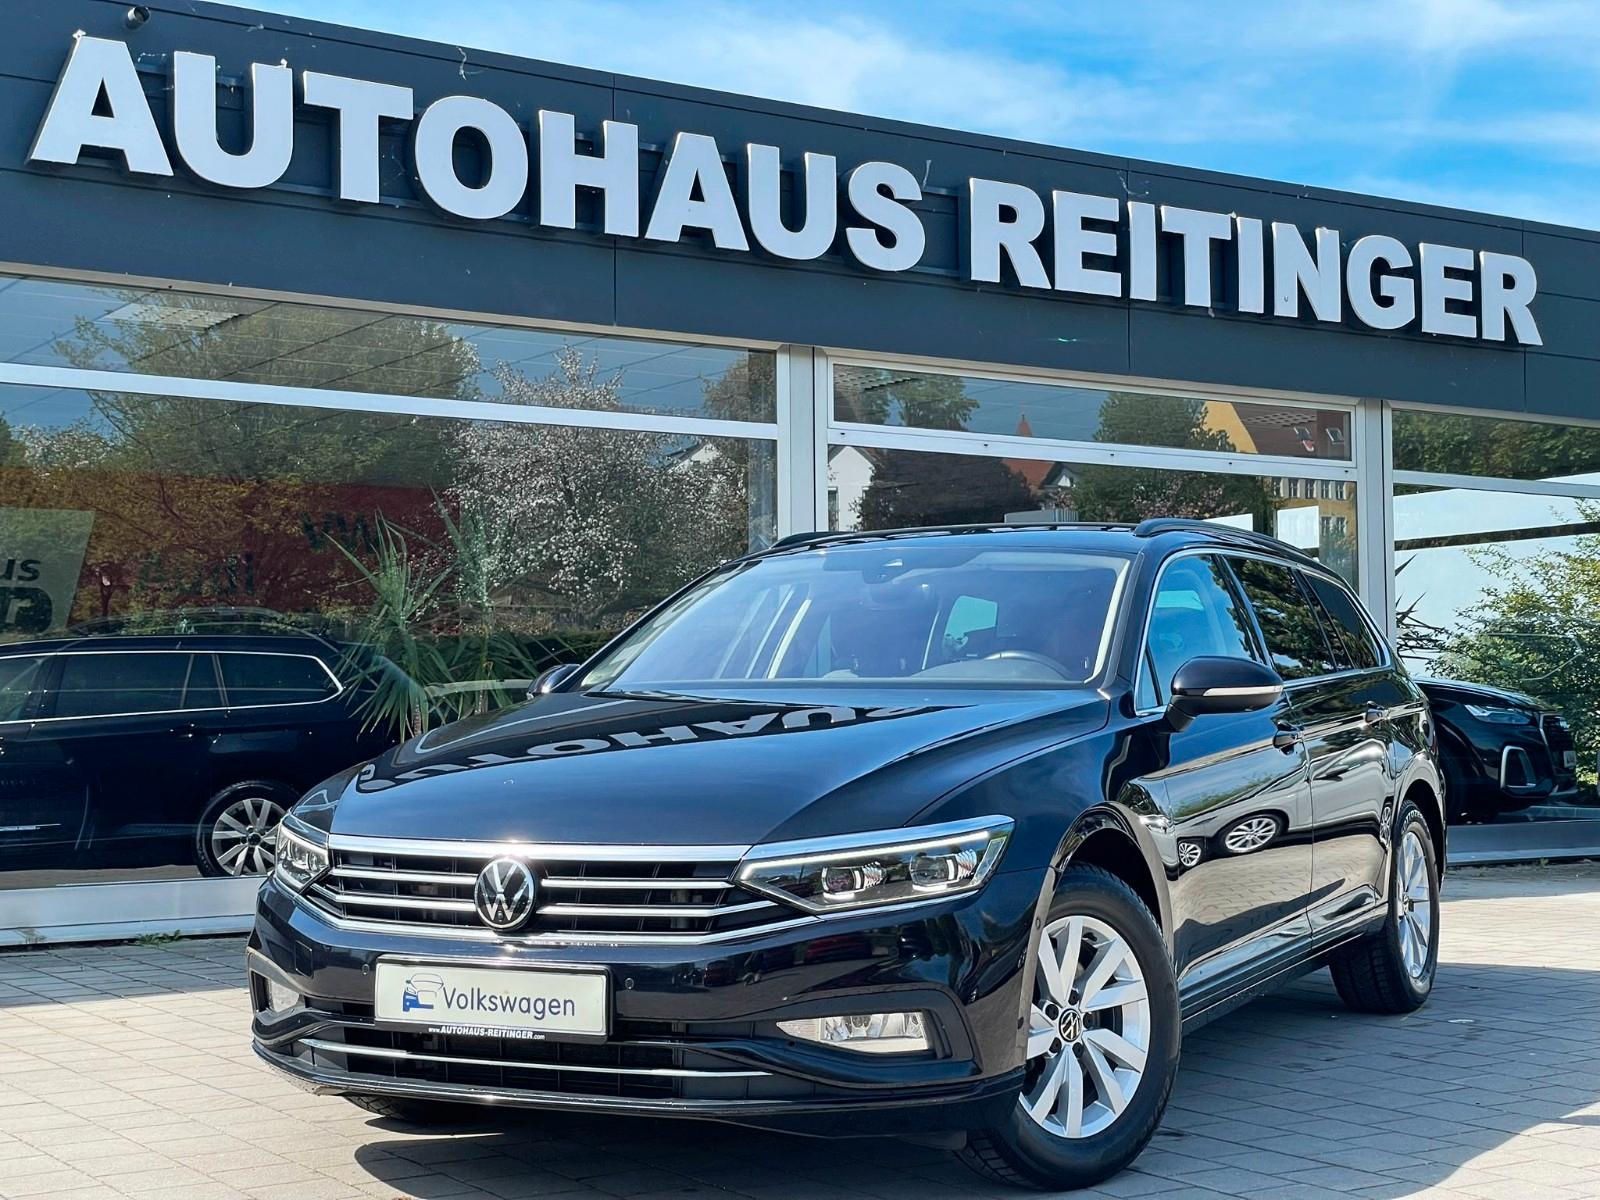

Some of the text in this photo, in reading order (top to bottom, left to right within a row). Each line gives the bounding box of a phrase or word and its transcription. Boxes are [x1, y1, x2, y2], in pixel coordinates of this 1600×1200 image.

[30, 35, 1543, 346] AUTOHAUS REITINGER
[476, 860, 532, 923] VW
[443, 986, 575, 1021] Volkswagen
[428, 1025, 546, 1040] www.AUTOHAUS-REITINGER.com
